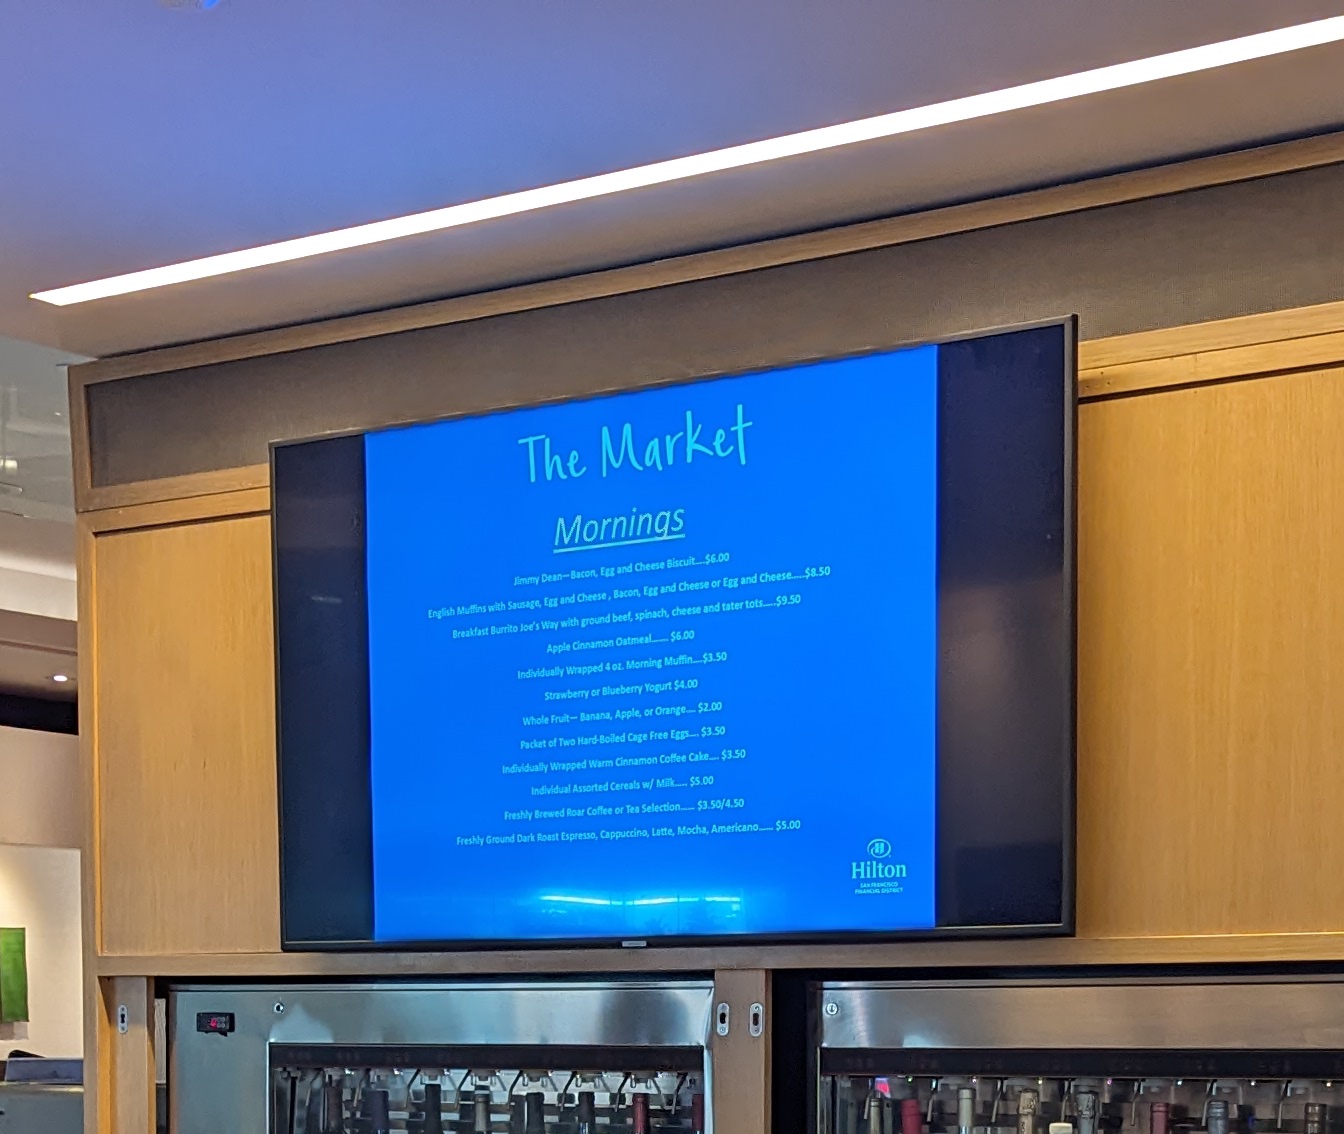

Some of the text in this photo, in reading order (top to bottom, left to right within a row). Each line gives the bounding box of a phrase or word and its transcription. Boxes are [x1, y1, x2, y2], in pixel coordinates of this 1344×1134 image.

[518, 403, 753, 483] The Market
[554, 507, 686, 553] Mornings
[512, 575, 540, 586] Jimmy
[599, 565, 615, 578] Egg
[616, 562, 633, 574] and
[633, 560, 665, 572] Cheese
[427, 606, 456, 620] English
[456, 603, 487, 615] Muffins
[486, 600, 506, 612] with
[506, 599, 542, 610] Sausage,
[543, 596, 559, 608] Egg
[558, 592, 576, 605] and
[576, 591, 607, 603] Cheese
[612, 588, 641, 599] Bacon,
[642, 585, 659, 597] Egg
[659, 581, 677, 594] and
[677, 580, 710, 592] Cheese
[710, 578, 722, 588] or
[722, 576, 739, 589] Egg
[739, 572, 758, 585] and
[451, 626, 489, 639] Breakfast
[489, 623, 519, 635] Burrito
[519, 620, 540, 632] Joe's
[540, 619, 559, 630] Way
[559, 616, 580, 628] with
[580, 612, 611, 628] ground
[611, 610, 633, 623] beef,
[634, 607, 670, 622] spinach,
[670, 605, 702, 617] cheese
[702, 601, 721, 613] and
[720, 600, 744, 611] tater
[545, 641, 571, 654] Apple
[571, 639, 614, 651] Cinnamon
[669, 629, 695, 643] $6.00
[516, 665, 565, 679] Individually
[564, 661, 604, 675] Wrapped
[625, 657, 663, 669] Morning
[543, 678, 699, 701] Strawberry or Blueberry Yogurt $4.00
[579, 711, 613, 722] Banana,
[614, 706, 642, 720] Apple,
[642, 707, 654, 717] or
[696, 700, 723, 714] $2.00
[519, 738, 547, 749] Packet
[547, 736, 557, 748] of
[557, 736, 576, 747] Two
[576, 731, 626, 745] Hard-Boiled
[626, 731, 648, 743] Cage
[648, 730, 669, 740] Free
[700, 725, 726, 738] $3.50
[501, 761, 549, 774] Individually
[548, 758, 587, 772] Wrapped
[587, 758, 614, 768] Warm
[614, 756, 658, 767] Cinnamon
[658, 752, 687, 764] Coffee
[720, 748, 746, 761] $3.50
[530, 783, 571, 795] Individual
[571, 780, 609, 793] Assorted
[609, 779, 641, 791] Cereals
[688, 774, 714, 787] $5.00
[503, 809, 533, 821] Freshly
[533, 807, 565, 819] Brewed
[565, 807, 585, 817] Roar
[585, 804, 613, 816] Coffee
[613, 806, 624, 814] or
[624, 803, 640, 814] Tea
[696, 797, 745, 812] $3.50/4.50
[455, 834, 485, 846] Freshly
[484, 832, 515, 844] Ground
[516, 832, 535, 843] Dark
[560, 831, 598, 842] Espresso,
[598, 827, 650, 840] Cappuccino,
[650, 826, 675, 837] Latte,
[676, 823, 710, 835] Mocha,
[774, 818, 801, 832] $5.00
[851, 860, 907, 879] Hilton
